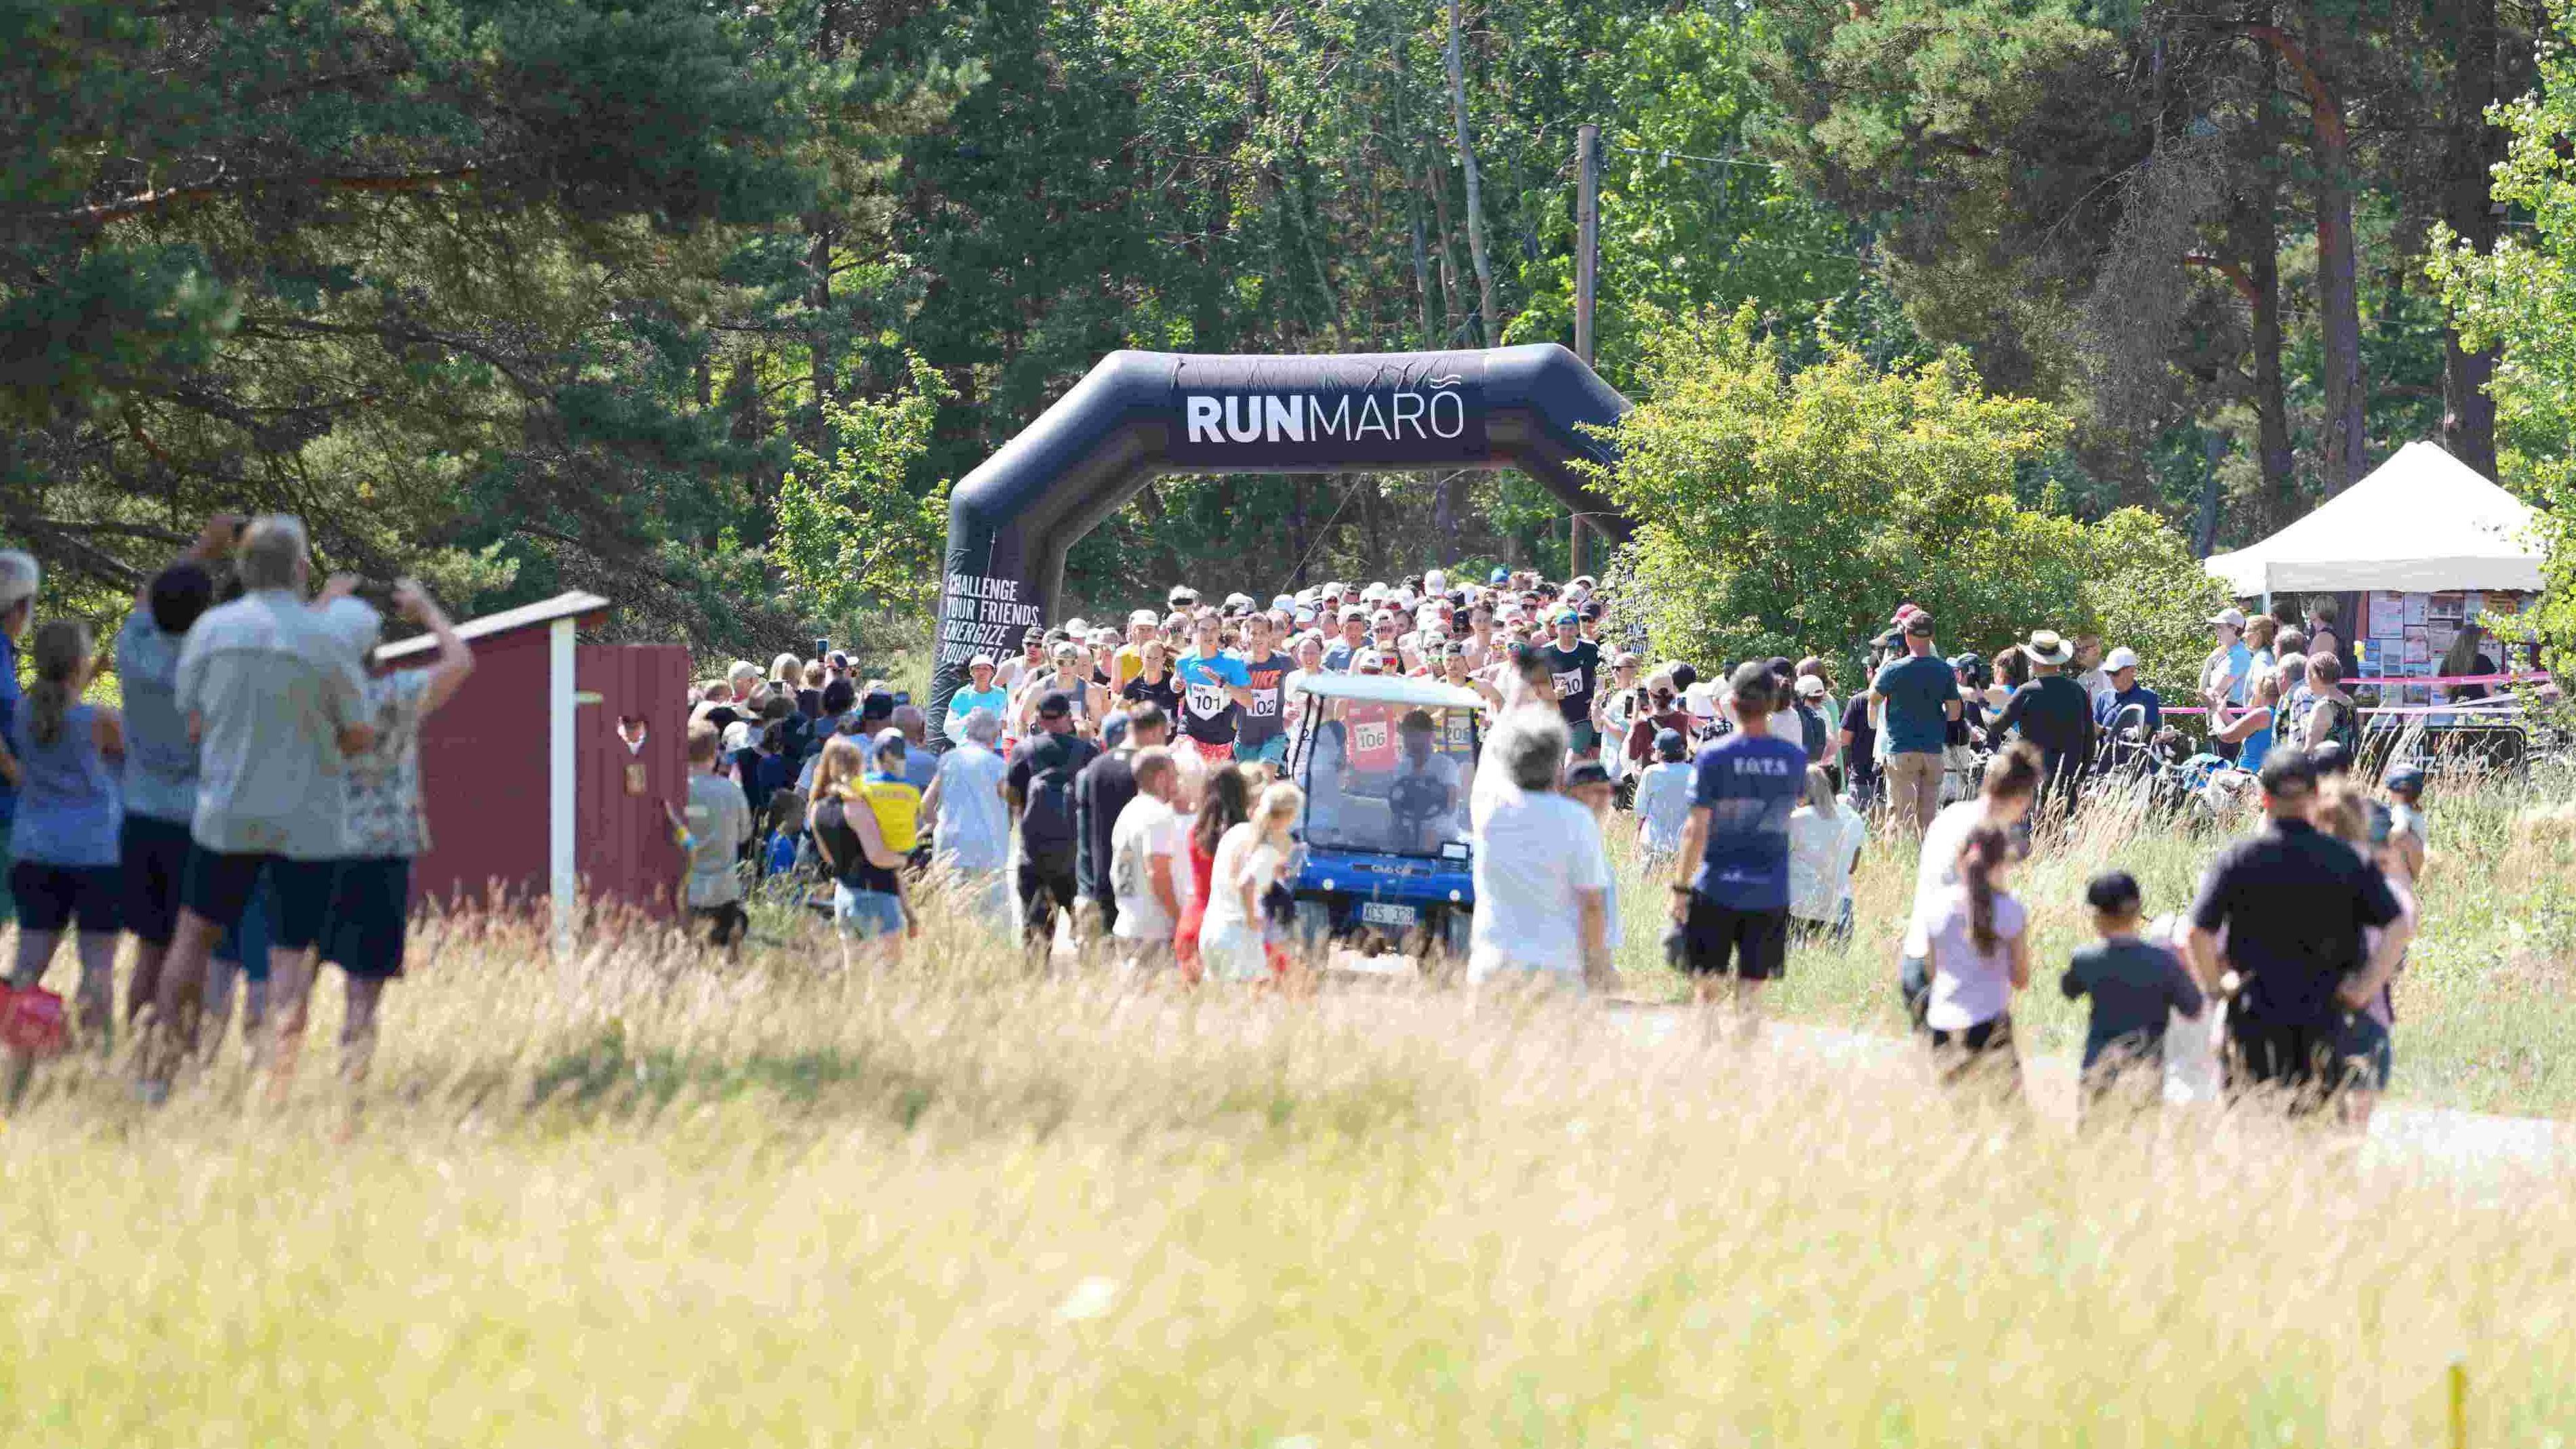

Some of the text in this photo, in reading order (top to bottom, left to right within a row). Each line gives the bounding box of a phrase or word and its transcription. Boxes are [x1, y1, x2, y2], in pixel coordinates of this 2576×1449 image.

[948, 574, 1019, 601] CHALLENGE
[947, 596, 1042, 627] YOUR FRIENDS.
[943, 619, 1010, 646] ENERGIZE
[1195, 695, 1220, 710] 101
[1359, 732, 1385, 748] 106
